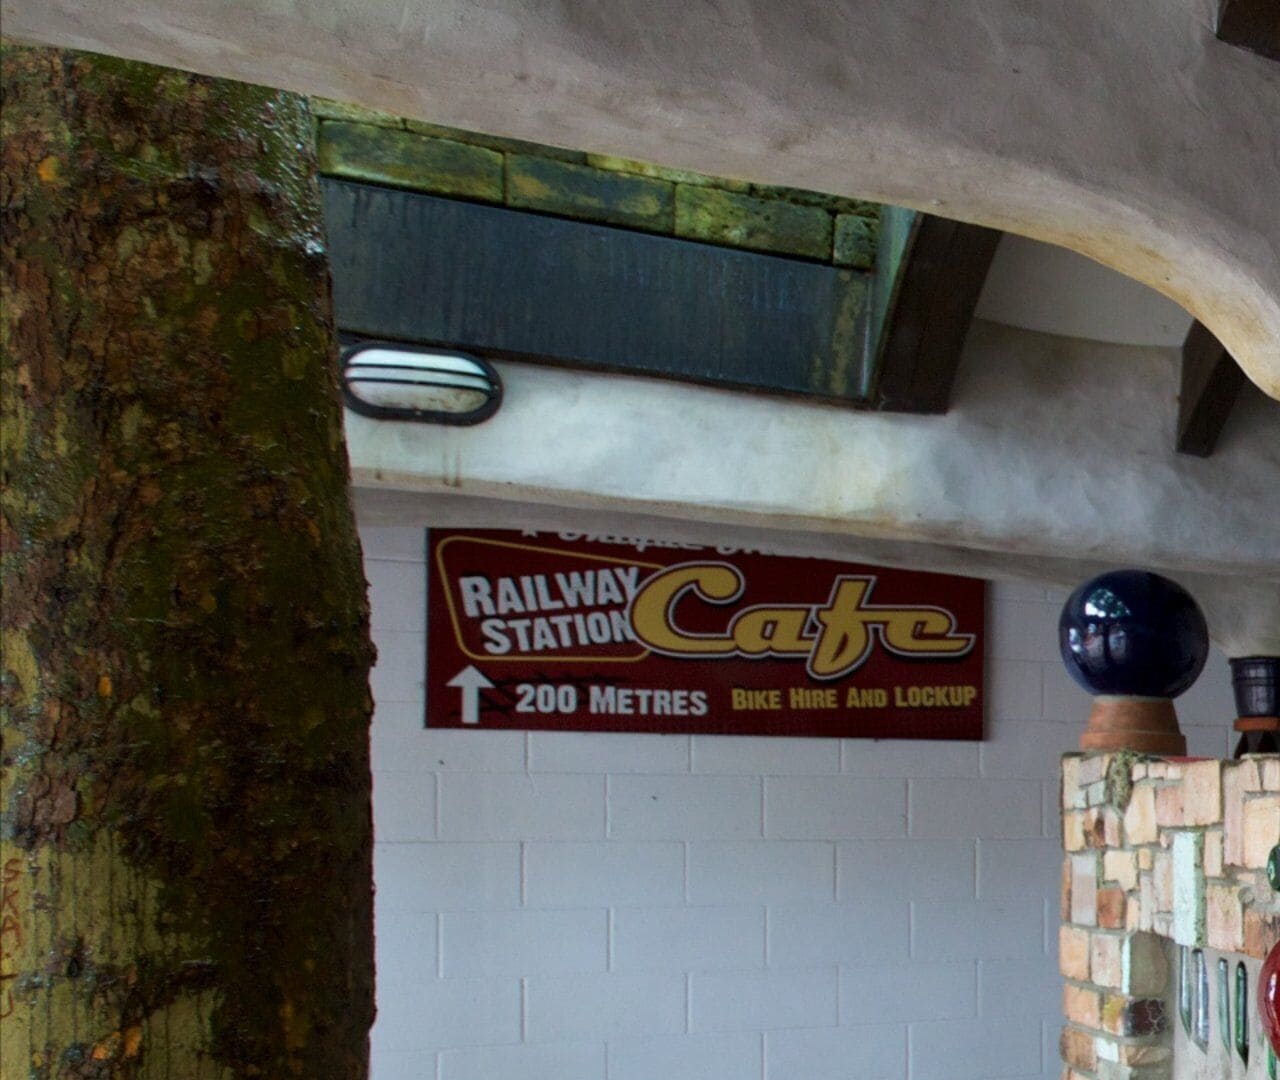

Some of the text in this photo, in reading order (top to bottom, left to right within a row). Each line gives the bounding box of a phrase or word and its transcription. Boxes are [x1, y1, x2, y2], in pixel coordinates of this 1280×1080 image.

[459, 567, 639, 617] RAILWAY
[481, 610, 636, 655] STATION
[627, 560, 976, 681] Cafe
[515, 683, 709, 716] 200 METRES
[732, 685, 976, 710] BIKE HIRE AND LOCKUP
